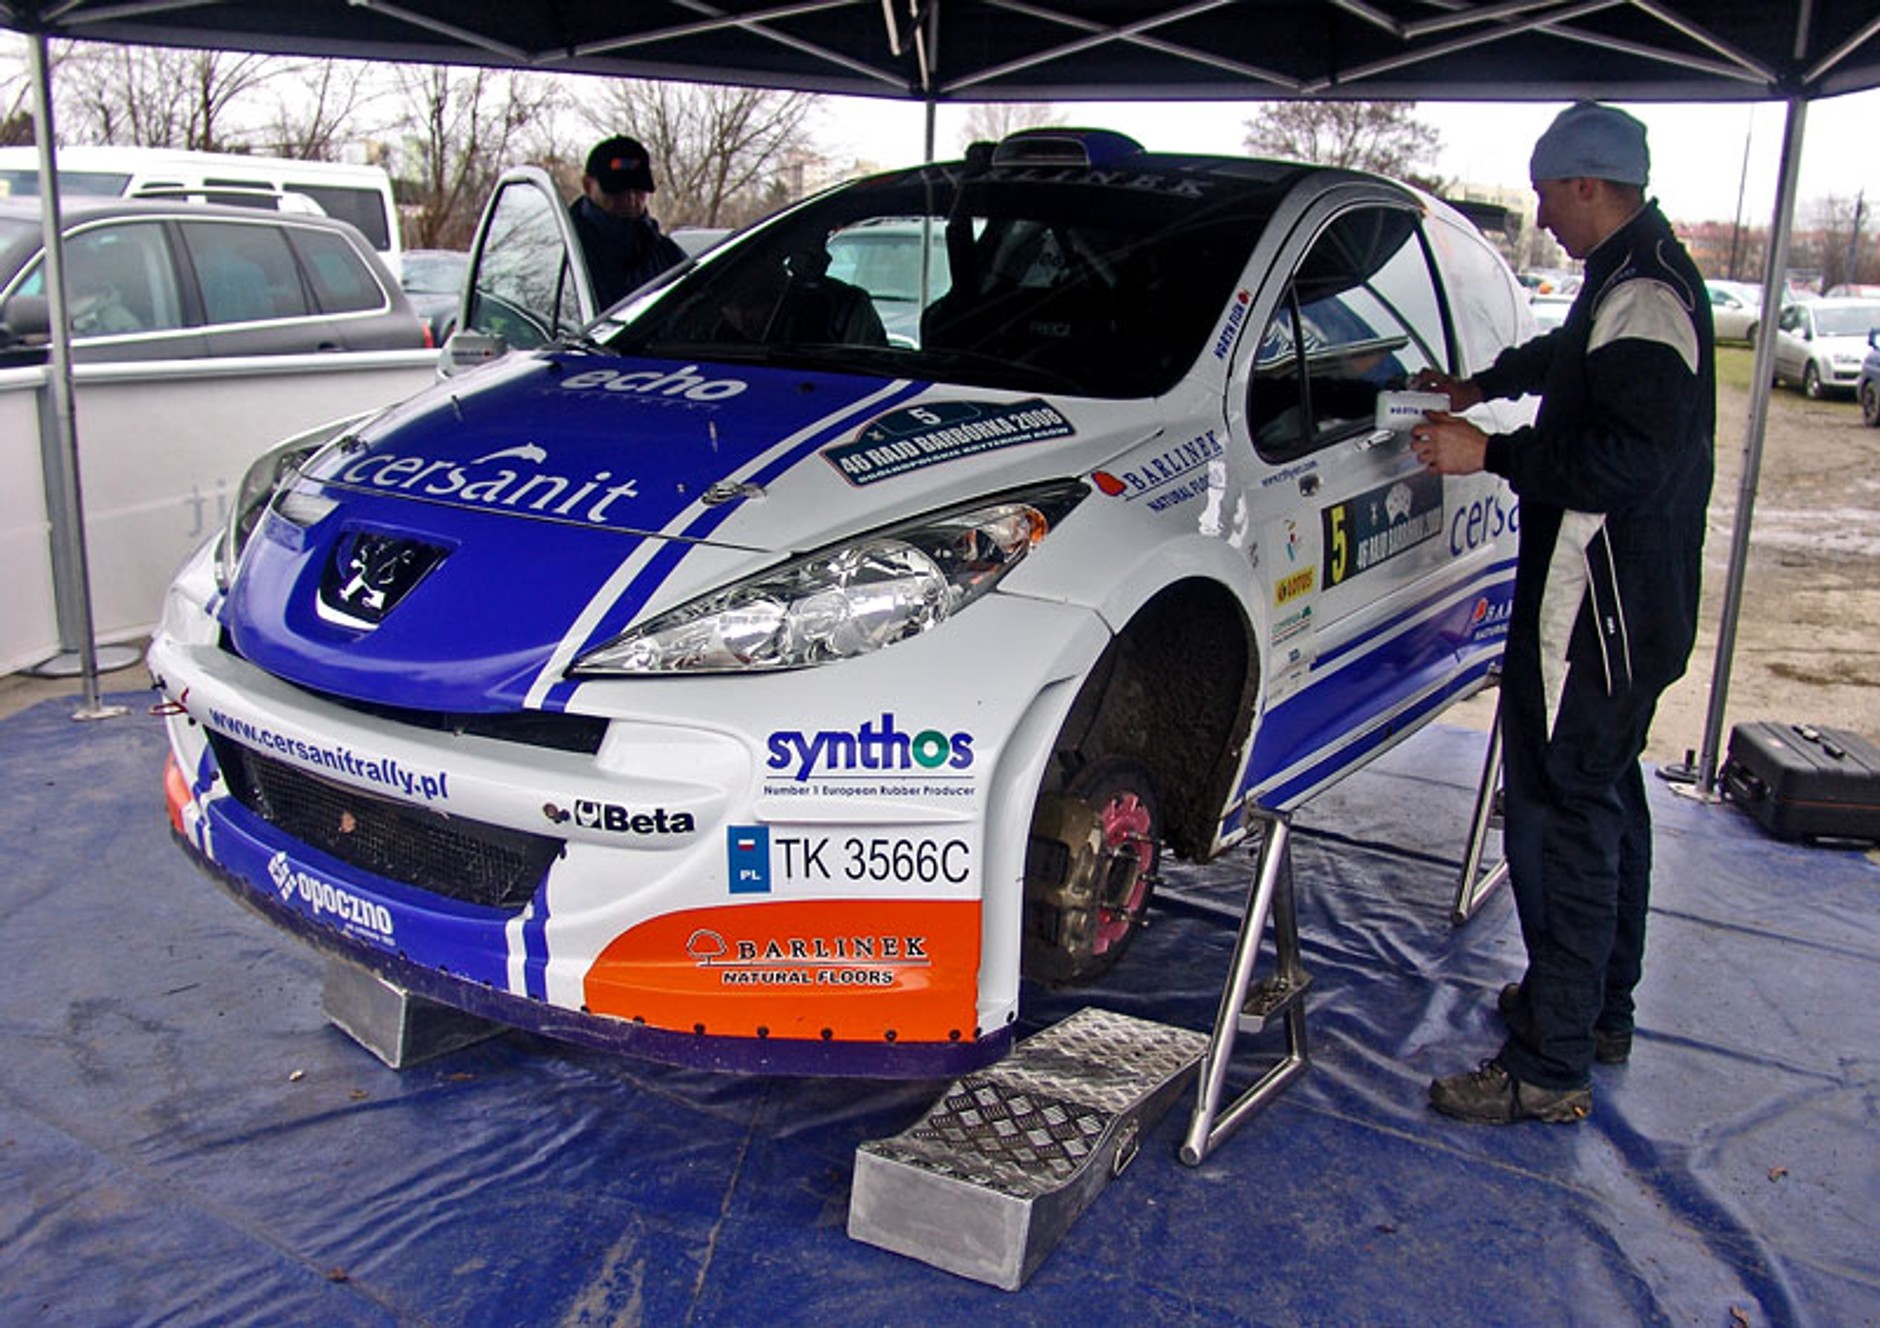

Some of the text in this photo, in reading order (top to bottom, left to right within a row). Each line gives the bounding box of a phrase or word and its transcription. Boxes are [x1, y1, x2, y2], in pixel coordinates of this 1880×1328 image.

[560, 364, 749, 401] echo
[910, 408, 941, 425] 5
[840, 453, 872, 475] 46
[865, 438, 920, 467] RAJD
[914, 417, 1018, 453] BARBÓRKA
[1121, 429, 1222, 490] BARLINEK
[343, 454, 639, 522] cersanit
[1330, 506, 1347, 584] 5
[209, 708, 448, 800] www.cersanitrally.pl
[766, 712, 974, 782] synthos
[764, 785, 810, 796] Number
[822, 785, 878, 798] European
[880, 785, 920, 796] Rubber
[923, 785, 975, 796] Producer
[604, 803, 695, 834] Beta
[740, 870, 761, 880] PL
[775, 838, 970, 883] TK 3566C
[297, 872, 394, 935] opoczno
[737, 936, 927, 961] BARLINEK
[722, 969, 894, 984] NATURAL FLOORS
